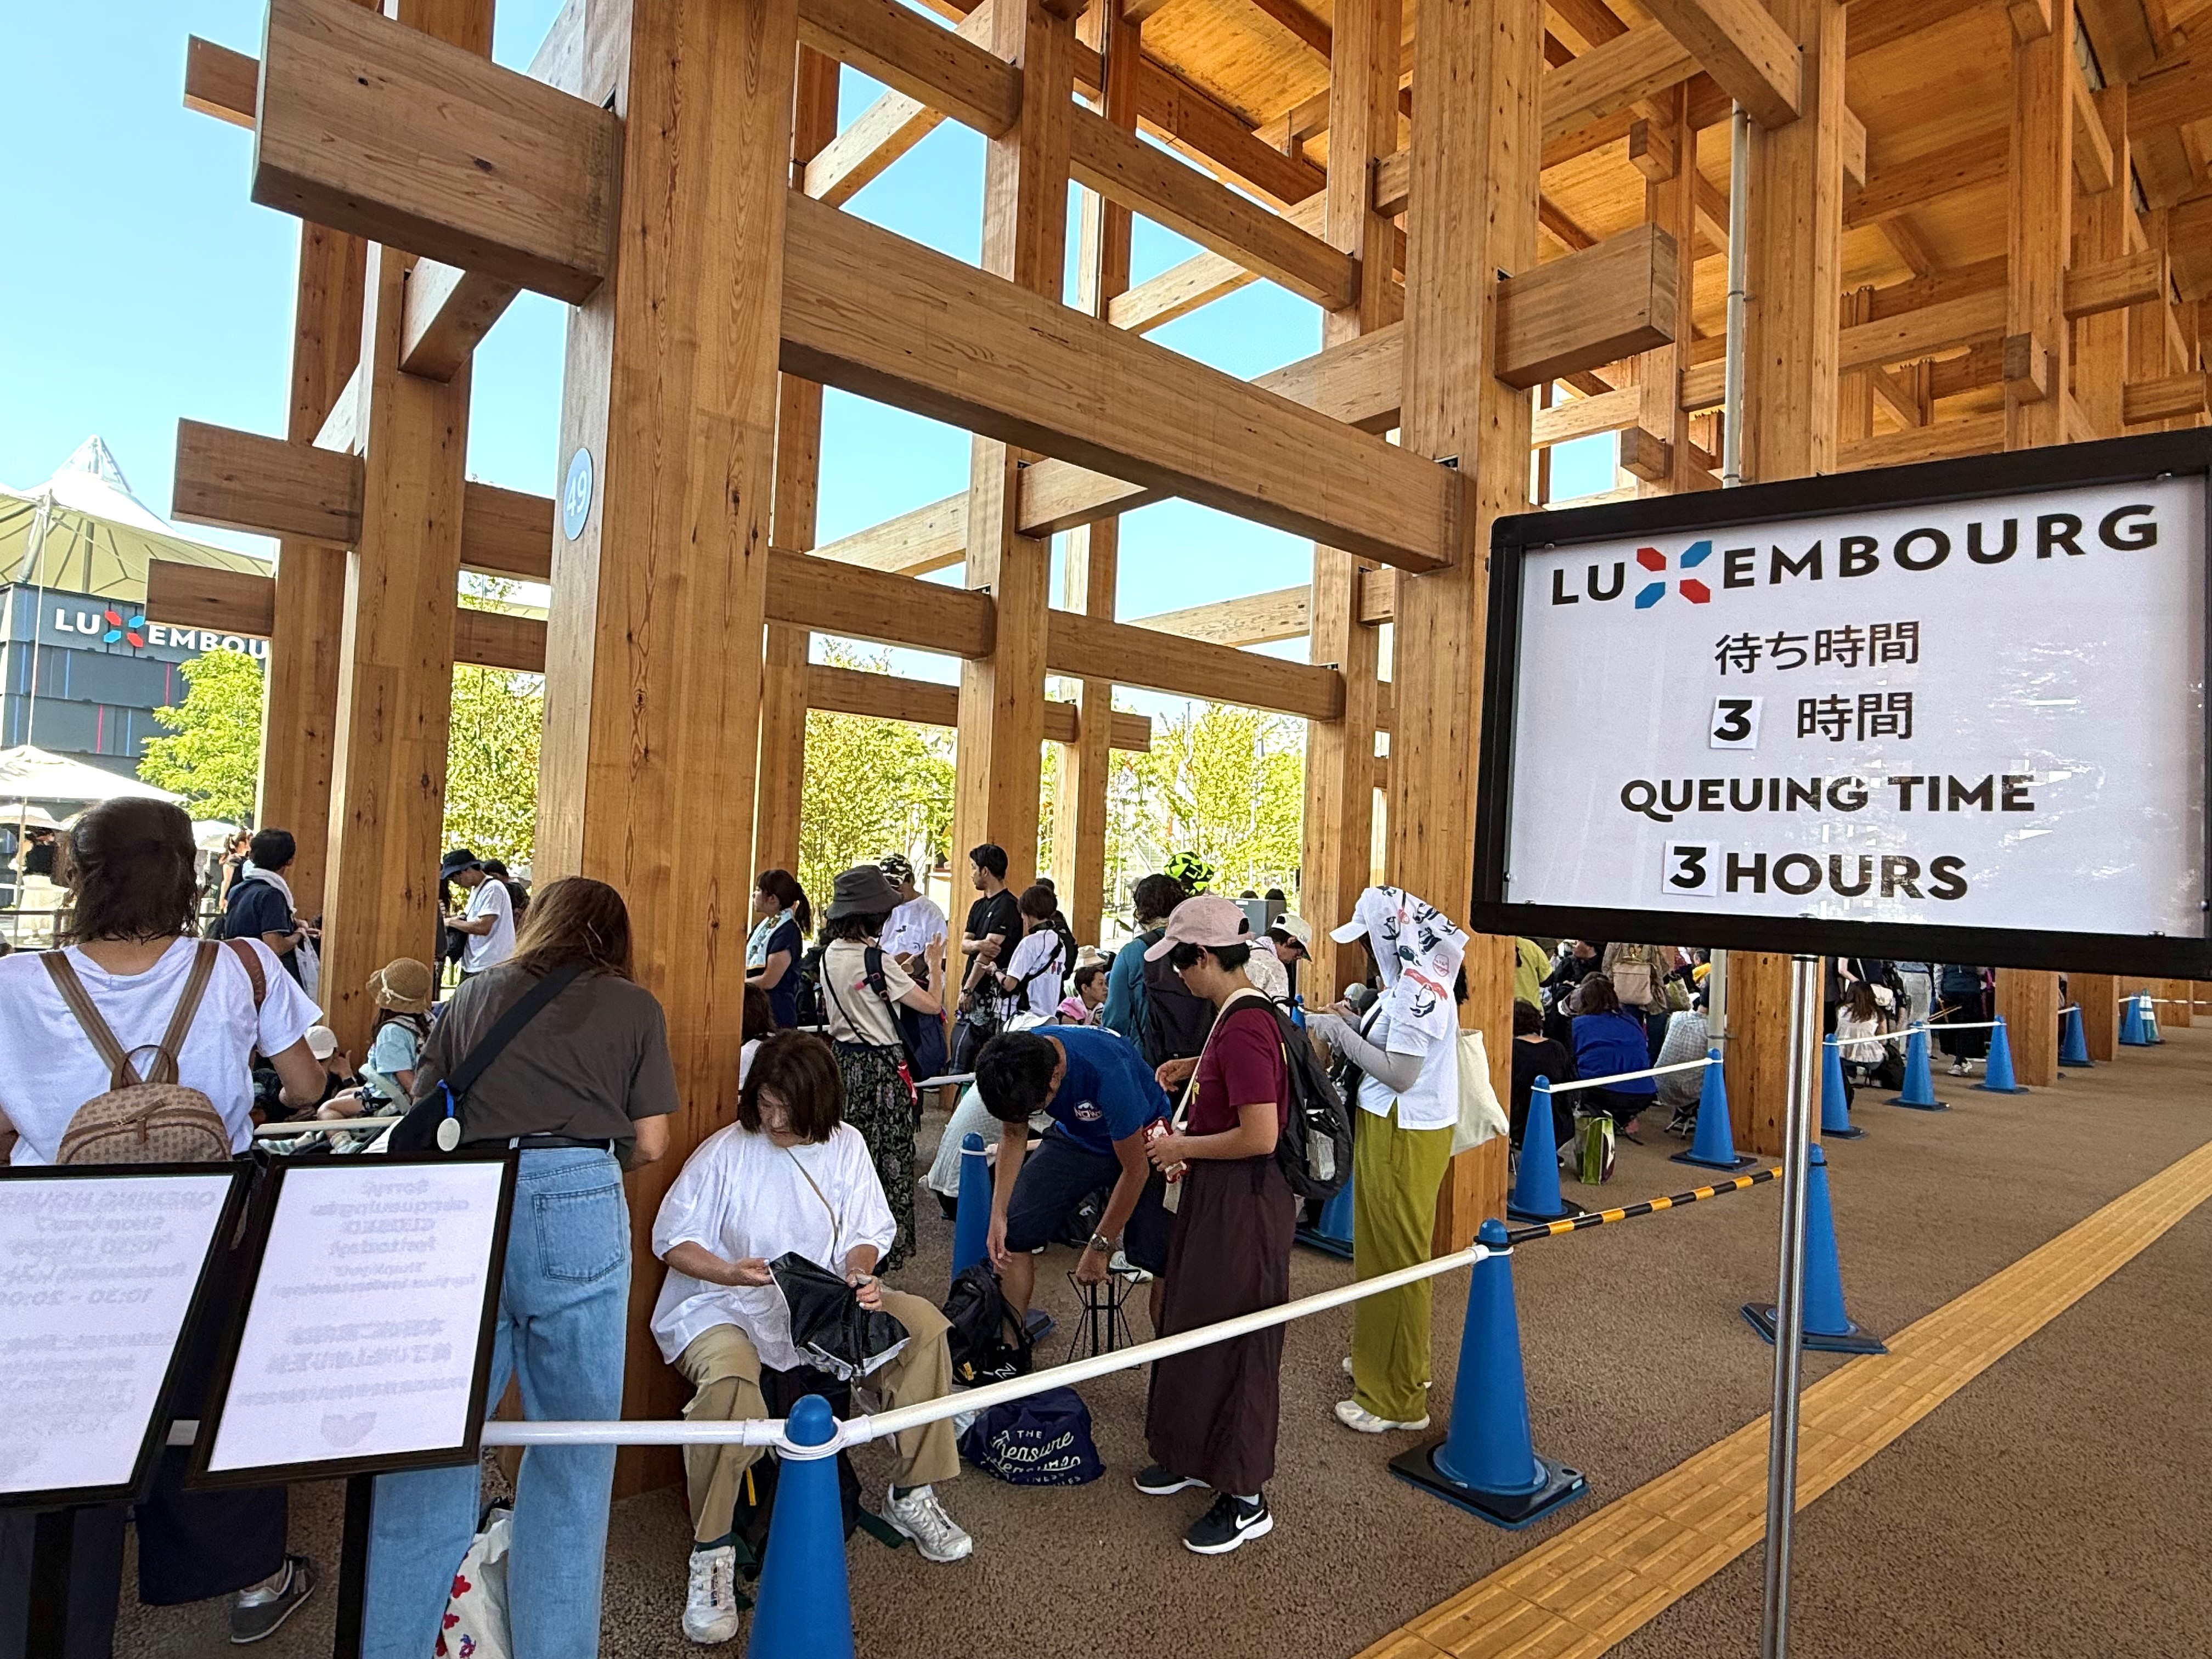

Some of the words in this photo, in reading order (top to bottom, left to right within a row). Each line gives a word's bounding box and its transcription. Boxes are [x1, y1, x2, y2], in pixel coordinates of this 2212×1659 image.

[566, 470, 587, 517] 49
[1551, 504, 2159, 608] LUXEMBOURG
[55, 608, 269, 659] LUXEMBOU
[1714, 620, 1919, 675] 待ち時間
[1713, 699, 1753, 741] 3
[1797, 692, 1912, 742] 時間
[1620, 775, 1869, 822] QUEUING
[1887, 775, 2035, 812] TIME
[1669, 845, 1708, 888] 3
[1725, 851, 1968, 900] HOURS
[1017, 1430, 1042, 1440] THE
